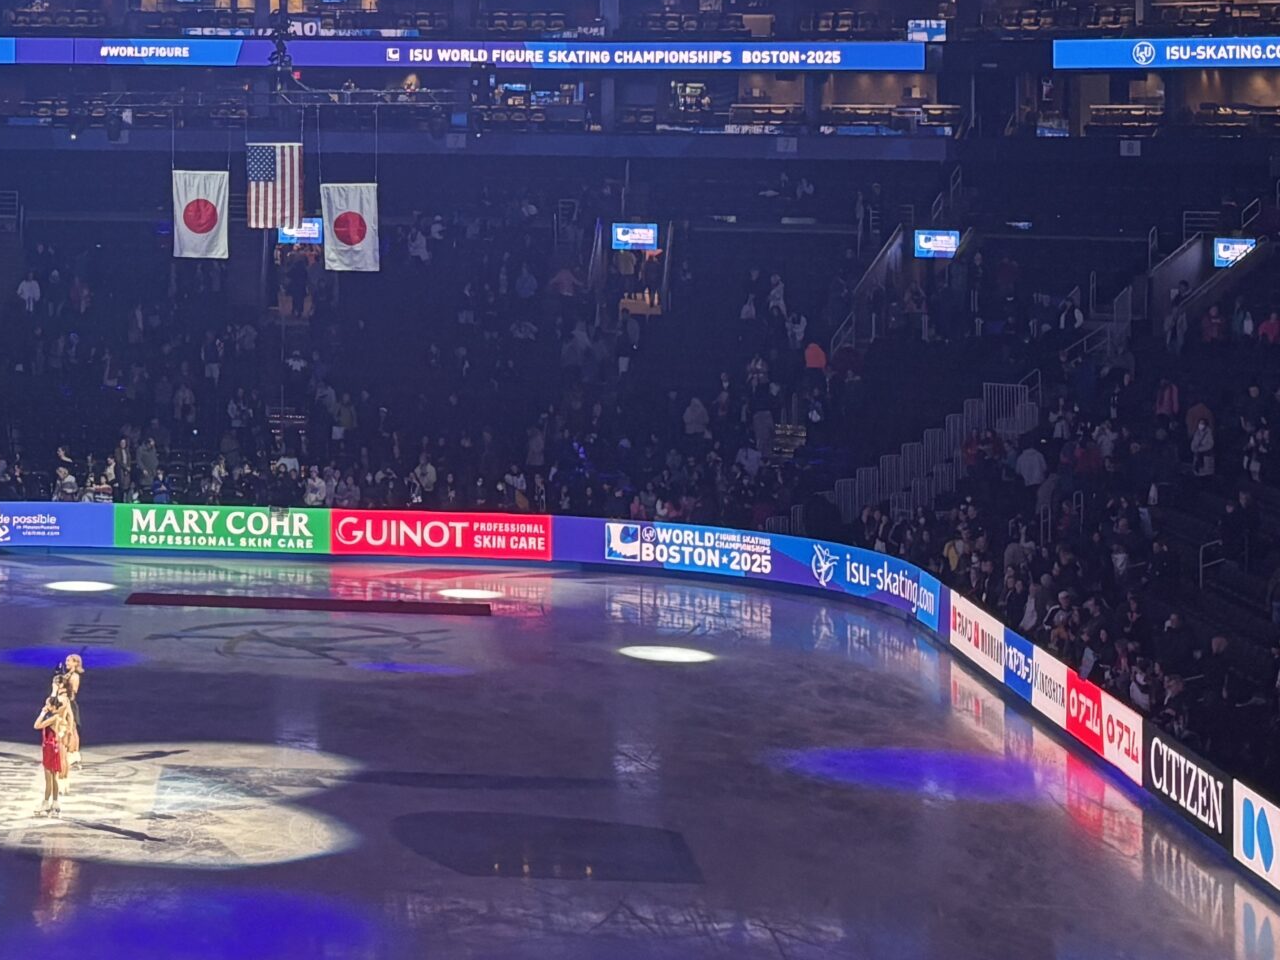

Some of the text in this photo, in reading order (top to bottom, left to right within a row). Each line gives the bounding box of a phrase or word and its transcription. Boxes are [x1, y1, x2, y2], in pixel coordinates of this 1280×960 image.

[409, 48, 433, 61] ISU
[437, 49, 488, 62] WORLD
[492, 50, 544, 62] FIGURE
[548, 50, 612, 64] SKATING
[614, 50, 732, 64] CHAMPIONSHIPS
[1166, 45, 1280, 60] ISU-SKATING.CO
[12, 514, 57, 526] possible
[131, 508, 313, 537] MARY COHR
[473, 522, 545, 534] PROFESSIONAL
[335, 517, 469, 548] GUINOT
[656, 527, 715, 547] WORLD
[130, 534, 313, 549] PROFESSIONAL SKIN CARE
[473, 535, 546, 551] SKIN CARE
[846, 554, 934, 616] isu-skating.com
[1150, 737, 1223, 834] CITIZEN
